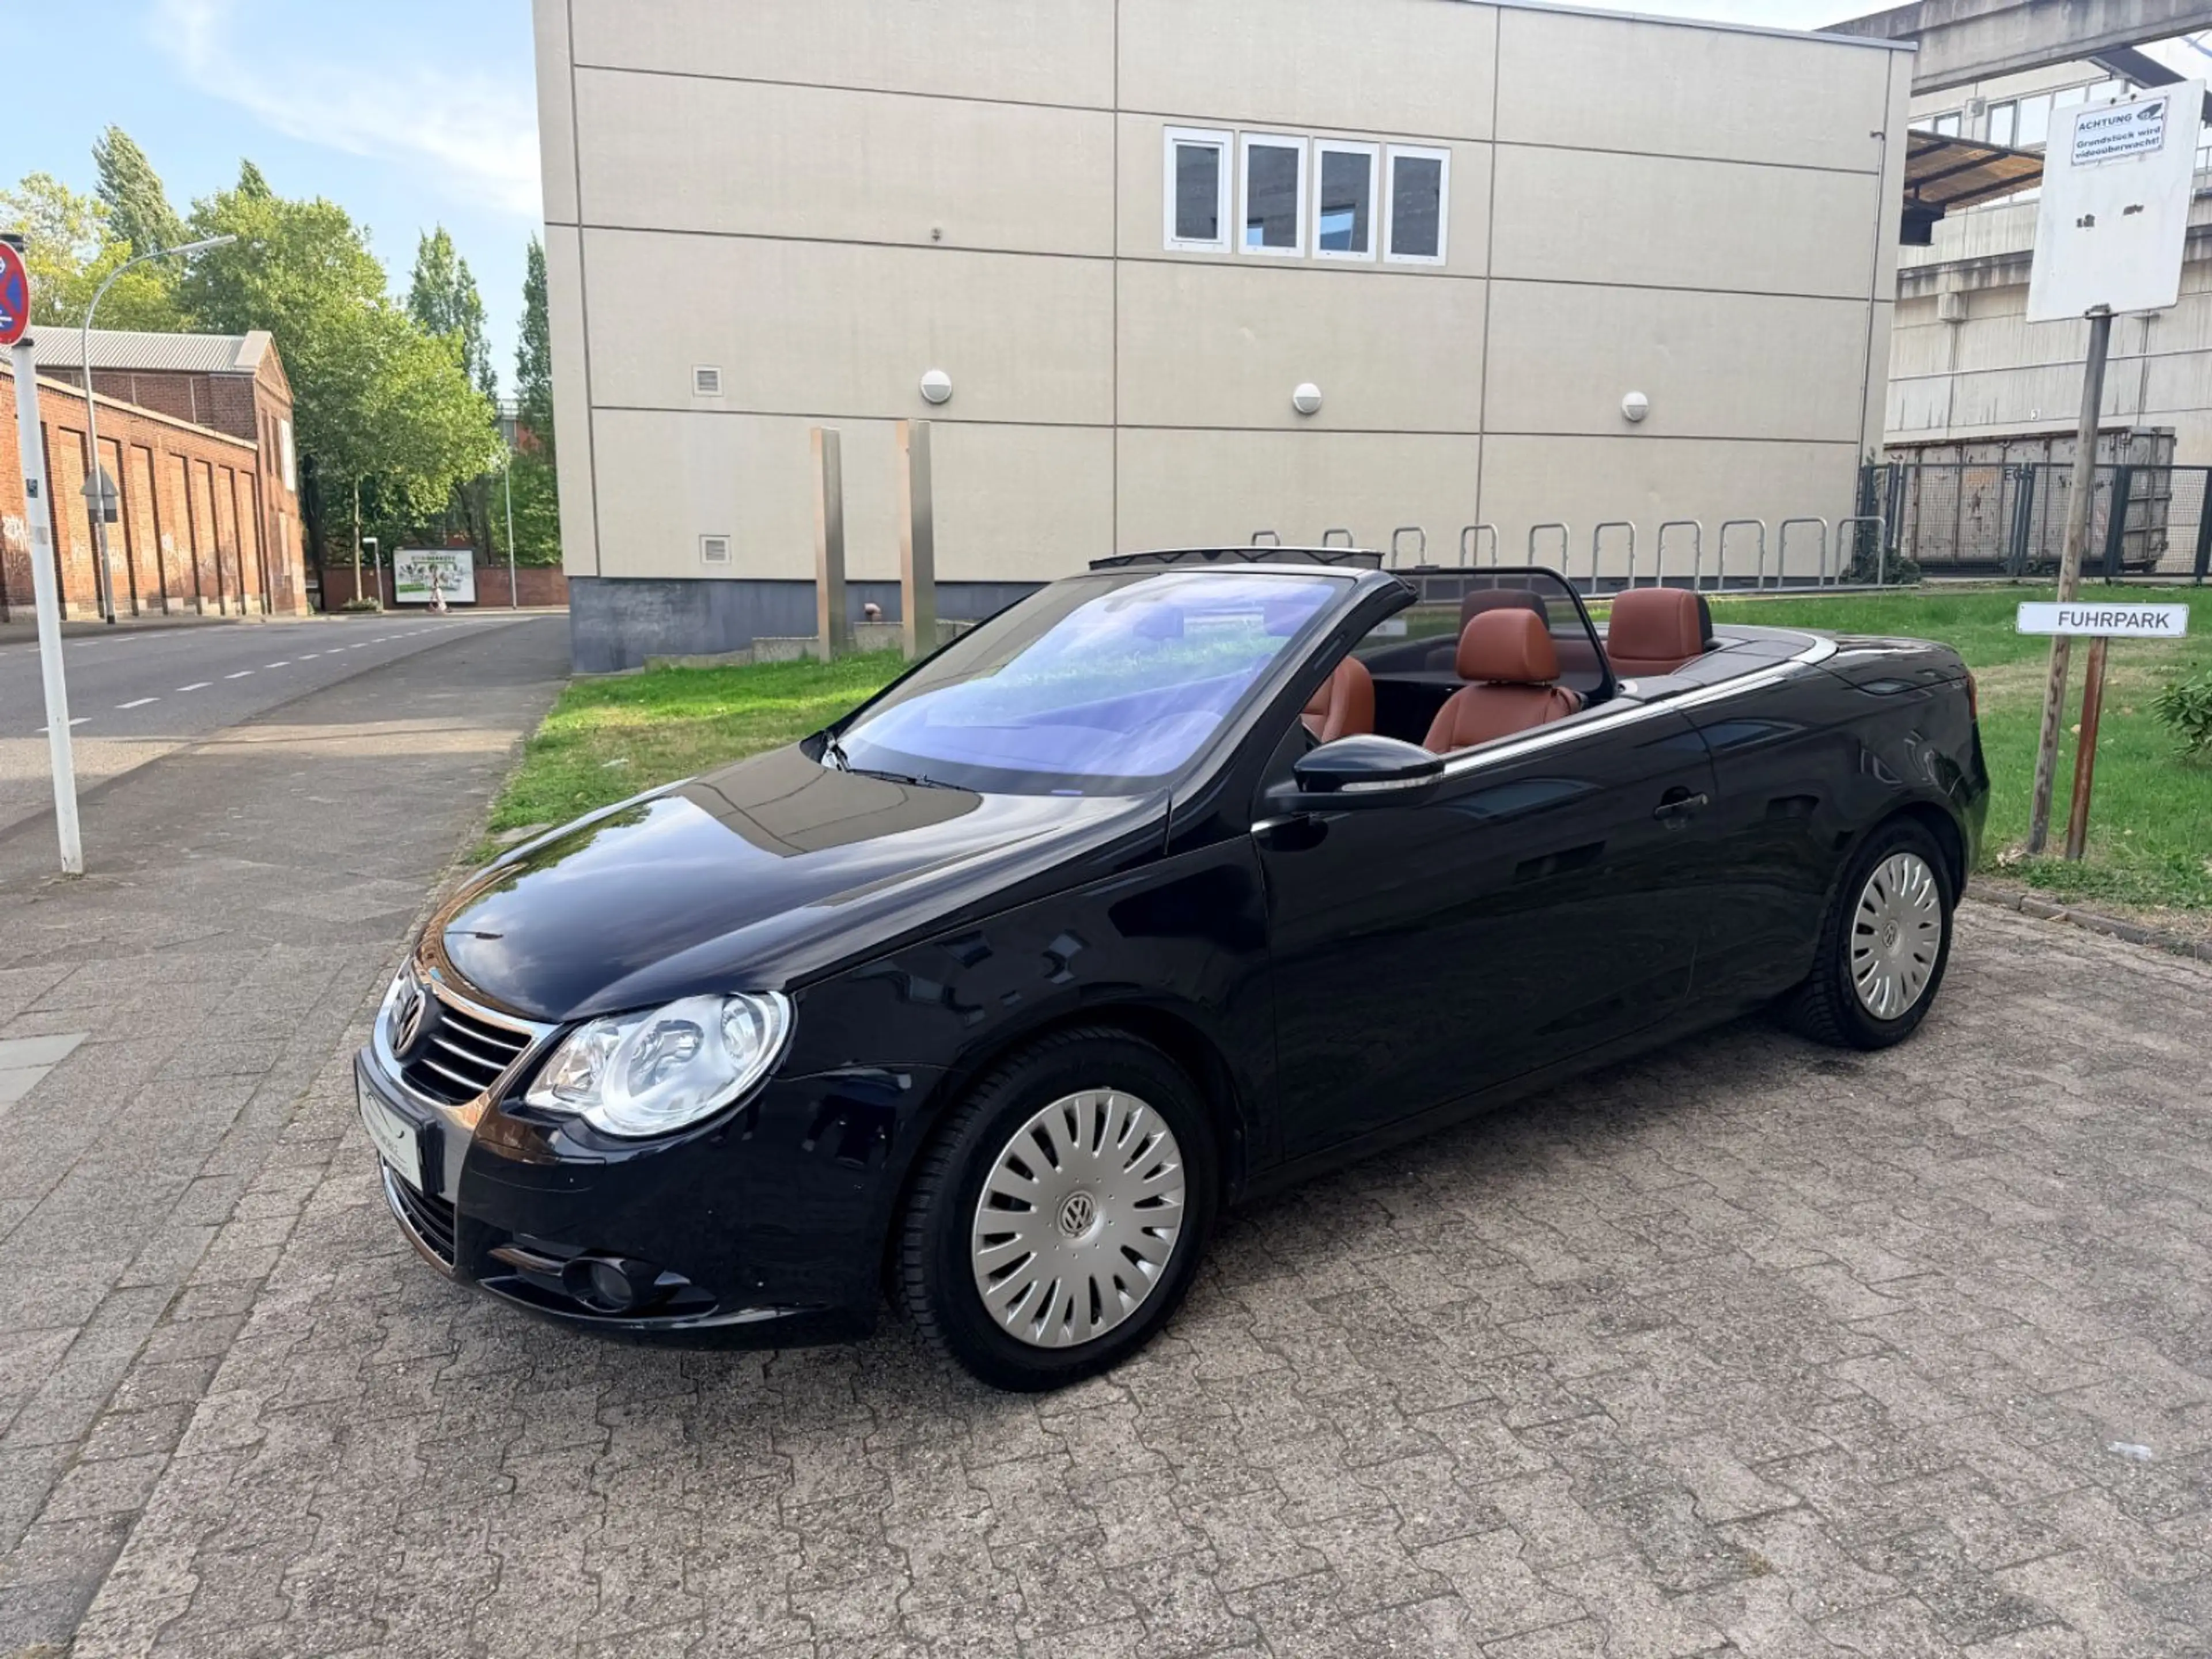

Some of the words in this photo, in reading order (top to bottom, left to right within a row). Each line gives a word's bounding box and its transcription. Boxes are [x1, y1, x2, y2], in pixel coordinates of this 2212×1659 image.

[2078, 113, 2133, 131] ACHTUNG
[2076, 131, 2134, 149] Grundstück
[2138, 126, 2161, 137] wird
[2058, 611, 2170, 629] FUHRPARK
[1060, 1196, 1093, 1234] VW
